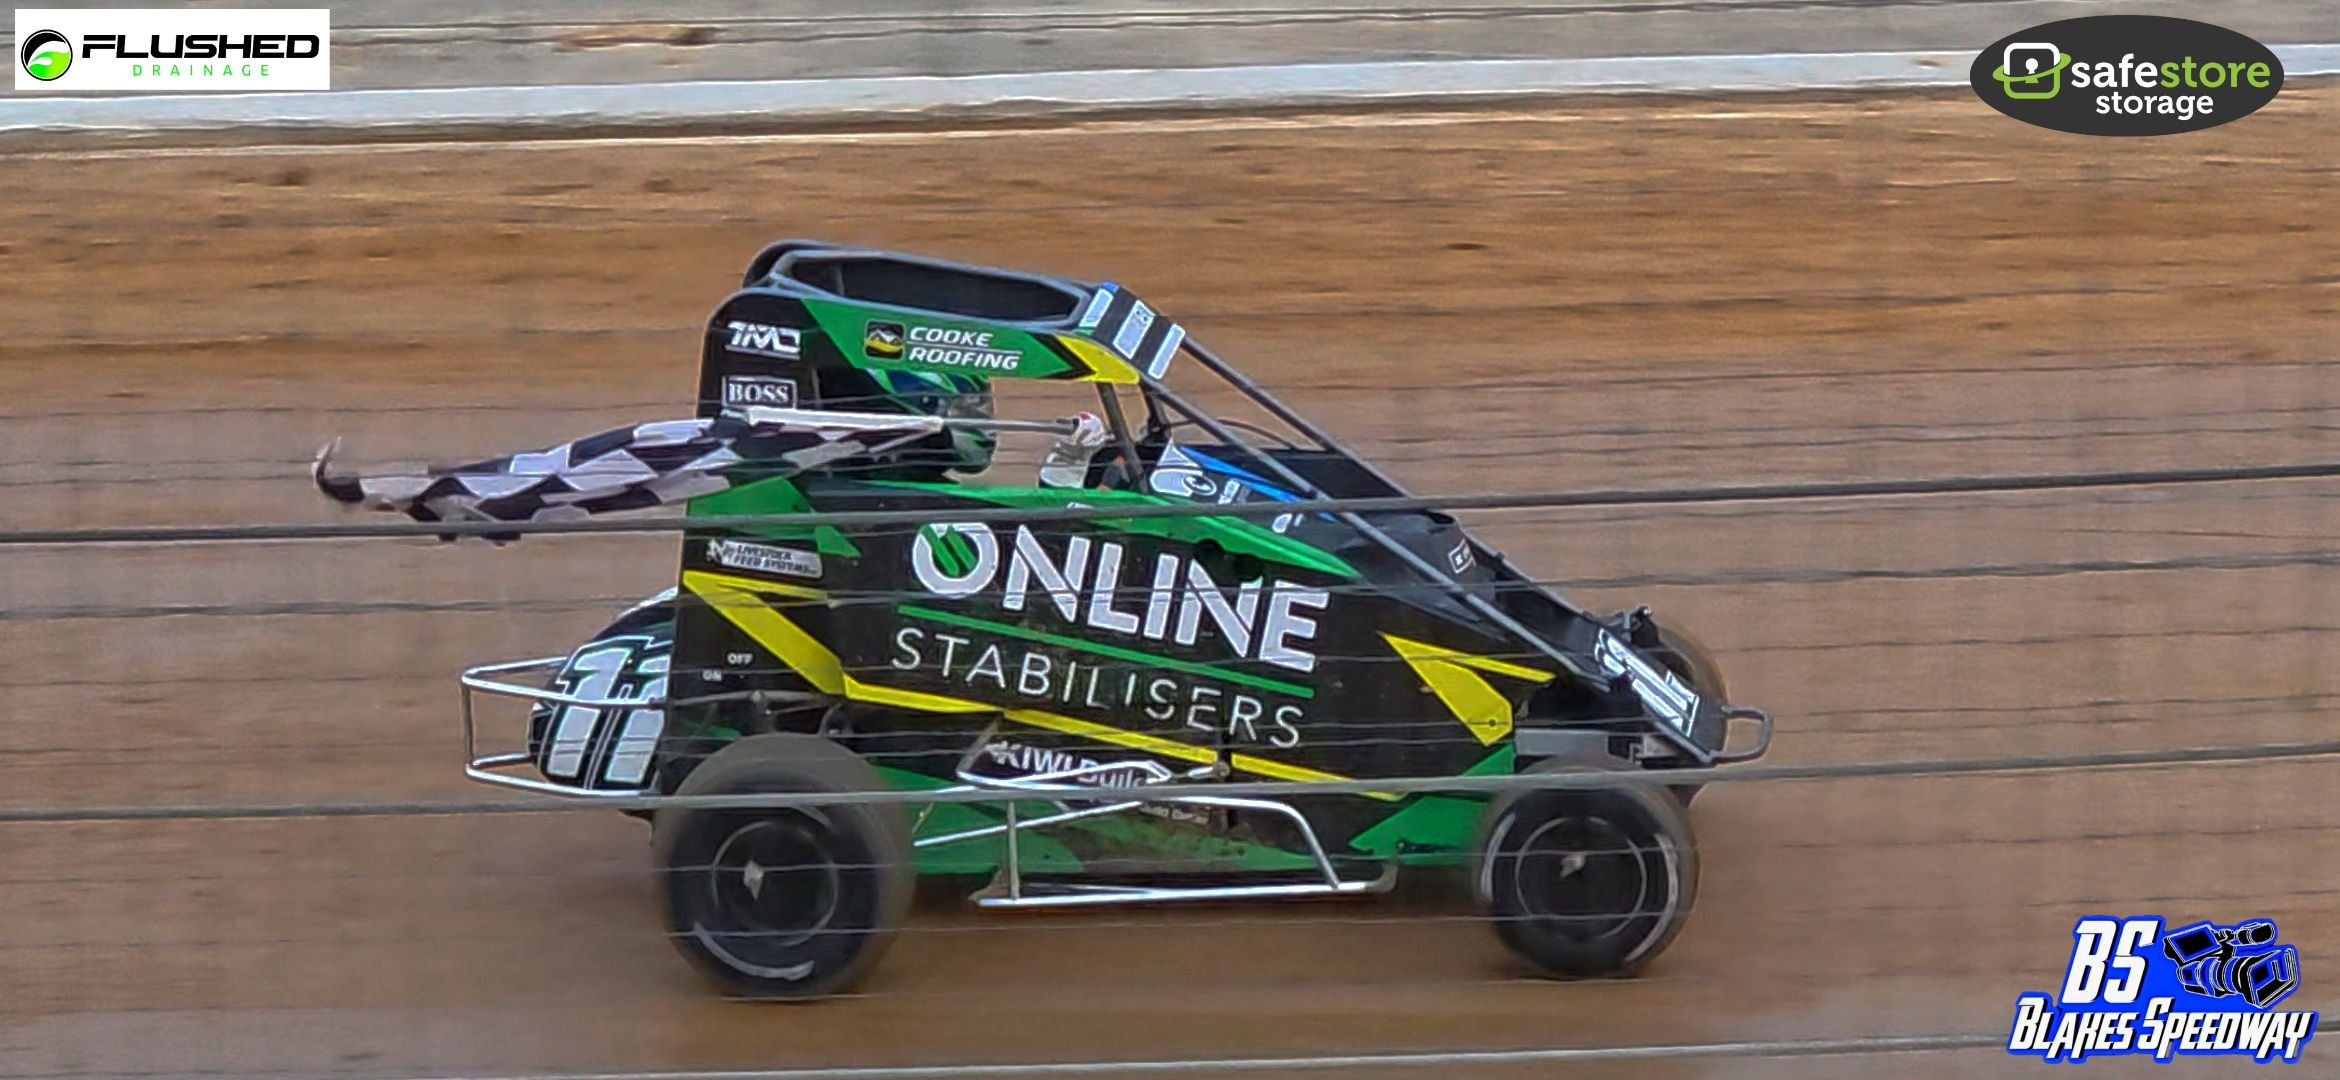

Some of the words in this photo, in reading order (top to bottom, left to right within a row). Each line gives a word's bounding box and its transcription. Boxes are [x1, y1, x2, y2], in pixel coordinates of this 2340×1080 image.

[908, 326, 993, 349] COOKE
[908, 347, 1021, 371] ROOFING
[728, 382, 789, 403] BOSS
[912, 522, 1330, 674] ONLINE
[727, 652, 754, 665] OFF
[703, 669, 722, 682] ON
[891, 627, 1305, 750] STABILISERS
